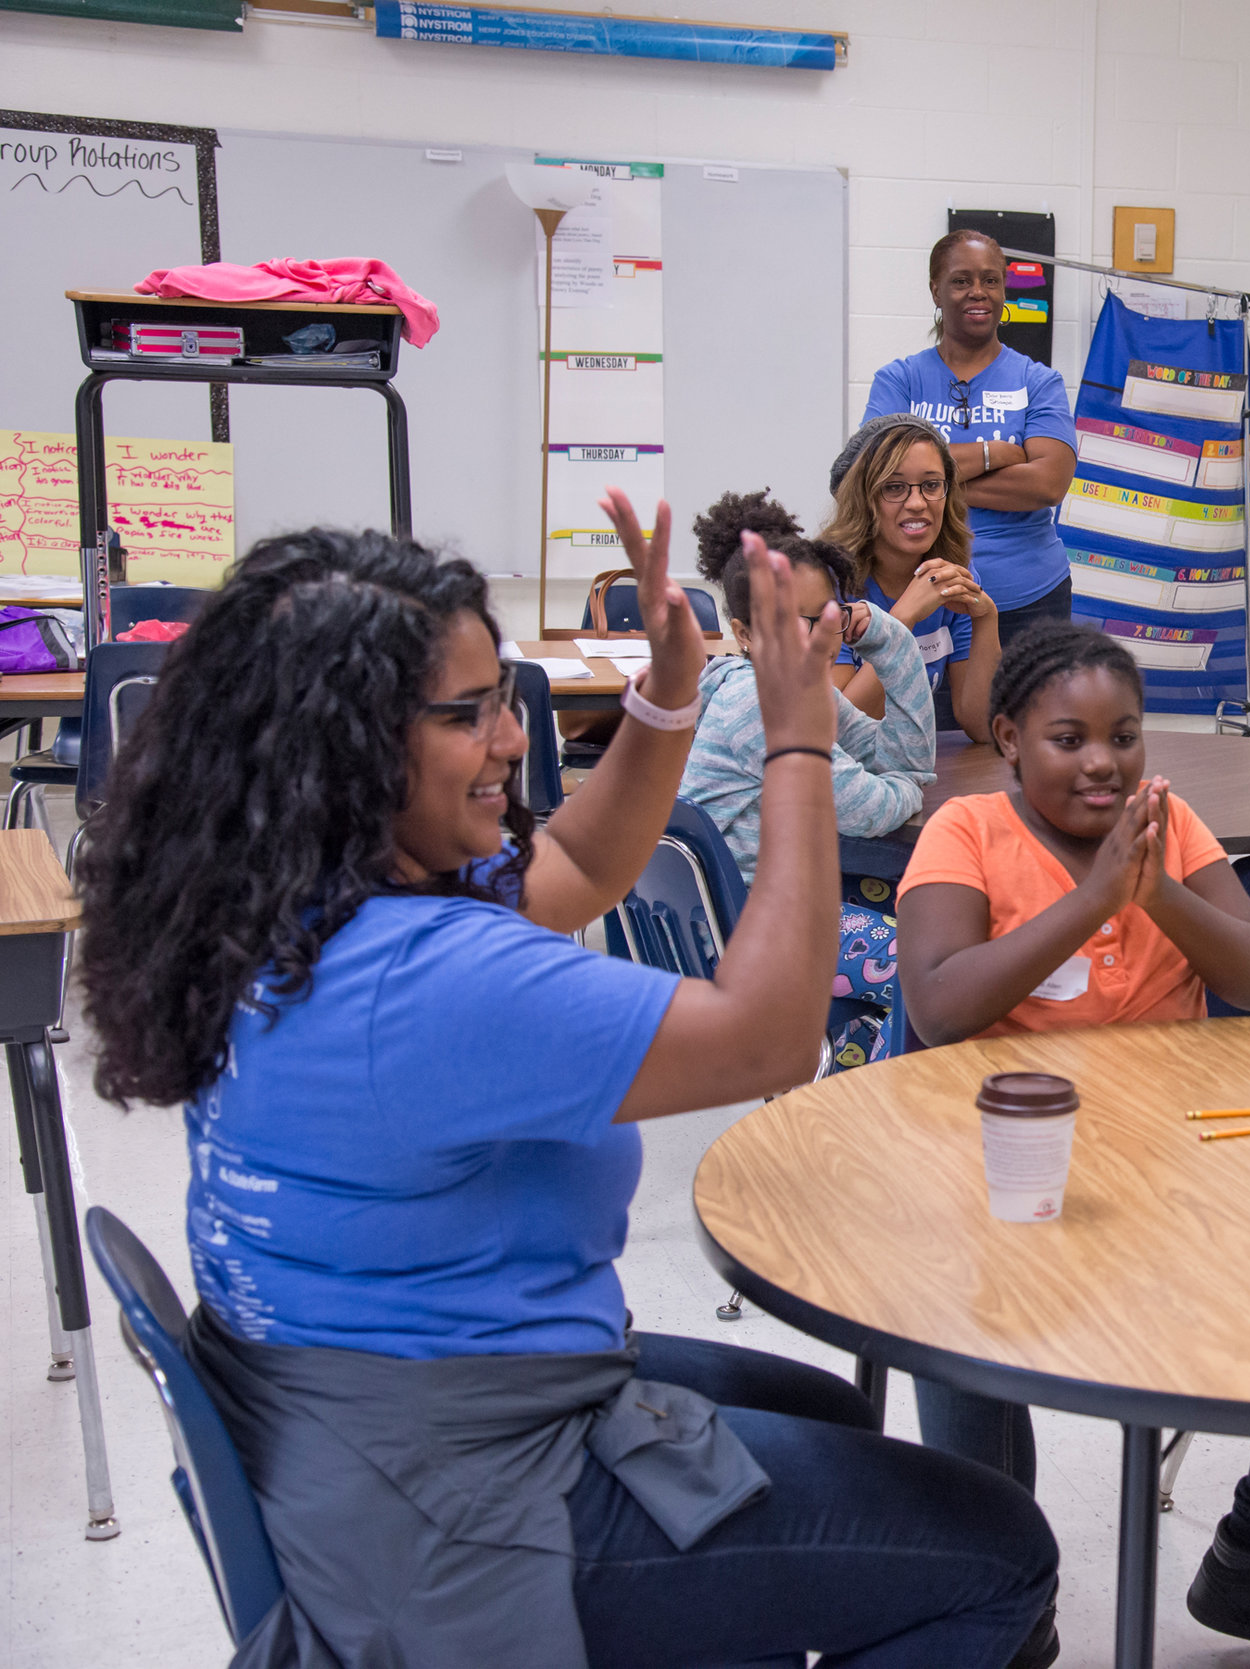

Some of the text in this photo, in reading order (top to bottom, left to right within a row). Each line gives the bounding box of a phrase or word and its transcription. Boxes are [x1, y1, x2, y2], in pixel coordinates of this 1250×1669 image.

[418, 7, 472, 19] NYSTROM
[419, 19, 474, 32] NYSTROM
[419, 33, 473, 44] NYSTROM
[0, 137, 180, 172] roup Rotations
[575, 356, 628, 369] WEDNESDAY
[1147, 365, 1175, 381] WORD
[1178, 371, 1192, 384] OF
[1194, 372, 1212, 387] THE
[911, 400, 1005, 424] VOLUNTEER
[1113, 425, 1174, 449] DEFINITION
[22, 440, 78, 455] I notice
[116, 445, 208, 461] I wonder
[581, 448, 625, 460] THURSDAY
[1082, 482, 1099, 496] USE
[1132, 492, 1138, 505] A
[130, 507, 178, 518] wonder
[186, 510, 206, 524] why
[591, 533, 620, 545] FRIDAY
[1088, 553, 1125, 569] RHYMES
[1130, 562, 1157, 577] WITH
[1189, 569, 1210, 581] HOW
[1145, 627, 1193, 641] SYLLABLES
